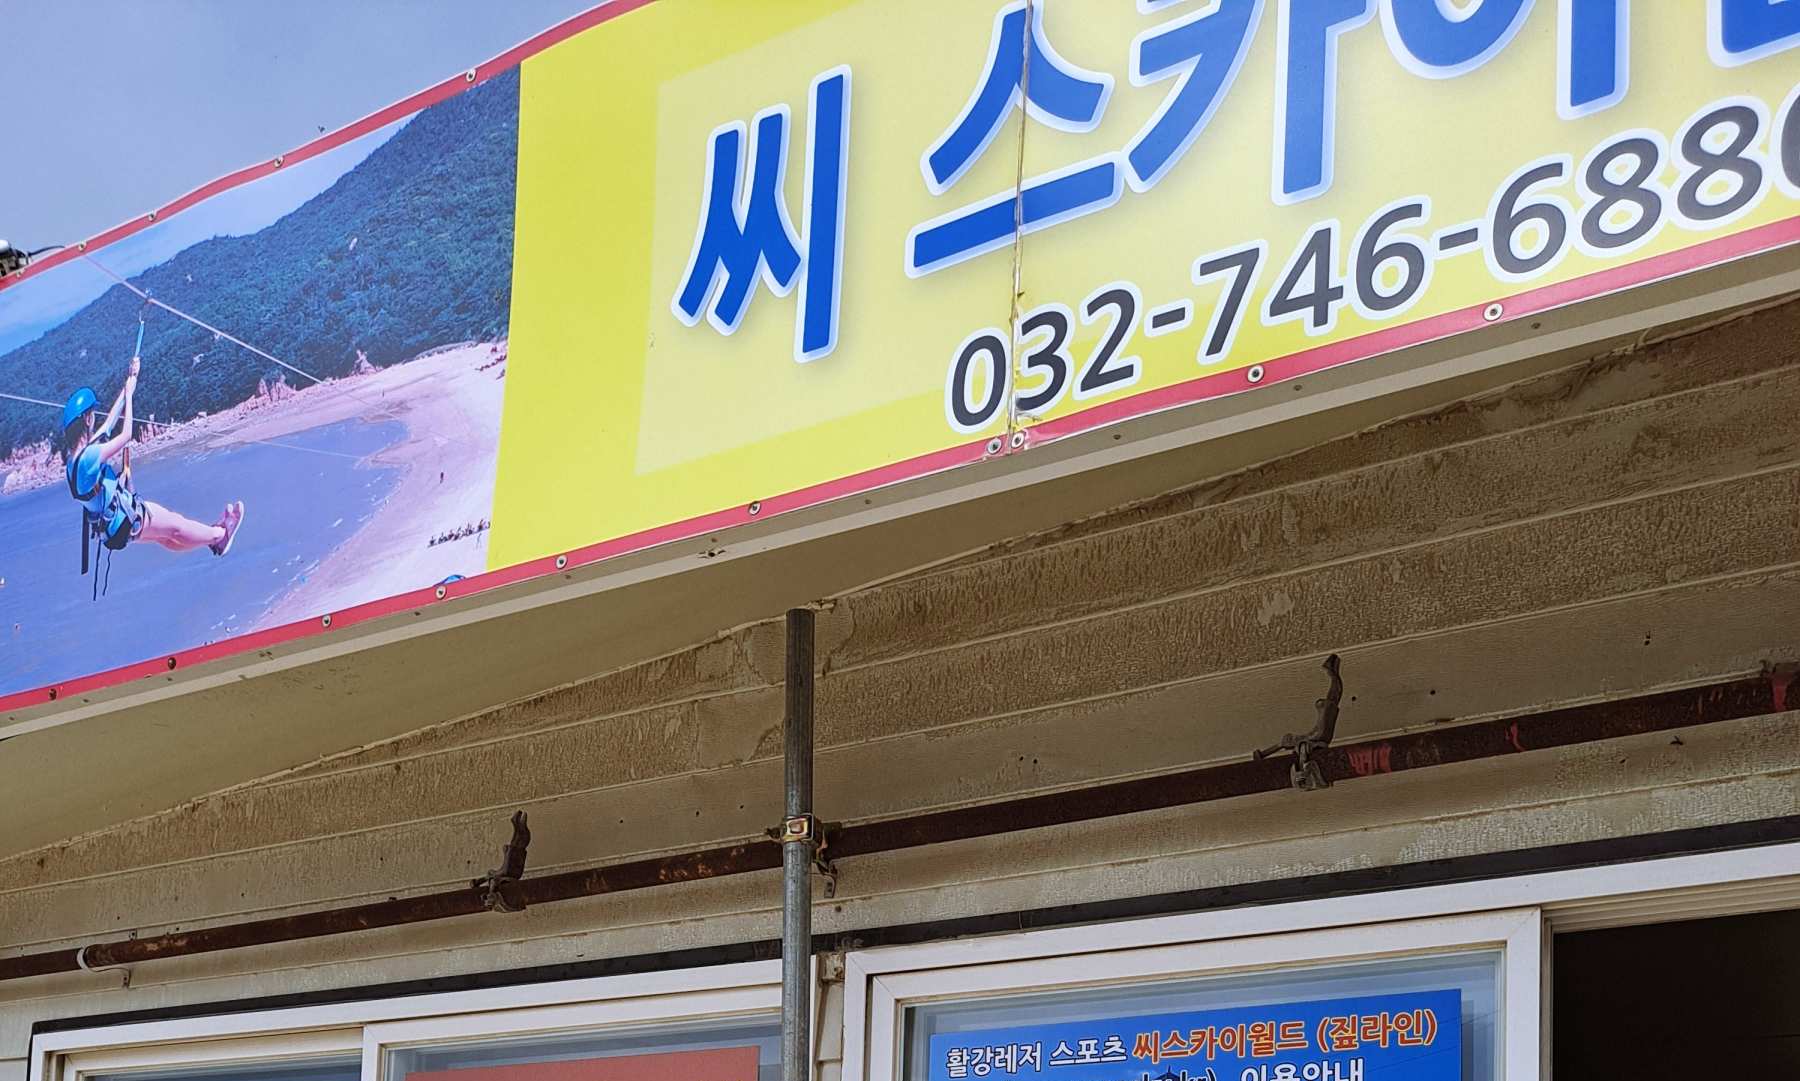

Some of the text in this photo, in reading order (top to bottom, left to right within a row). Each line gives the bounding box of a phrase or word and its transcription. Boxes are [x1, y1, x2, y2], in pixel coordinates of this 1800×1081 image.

[954, 93, 1800, 424] 032-746-688
[946, 1009, 1437, 1079] 활강레저 스포츠 씨스카이월드 (짚라인)
